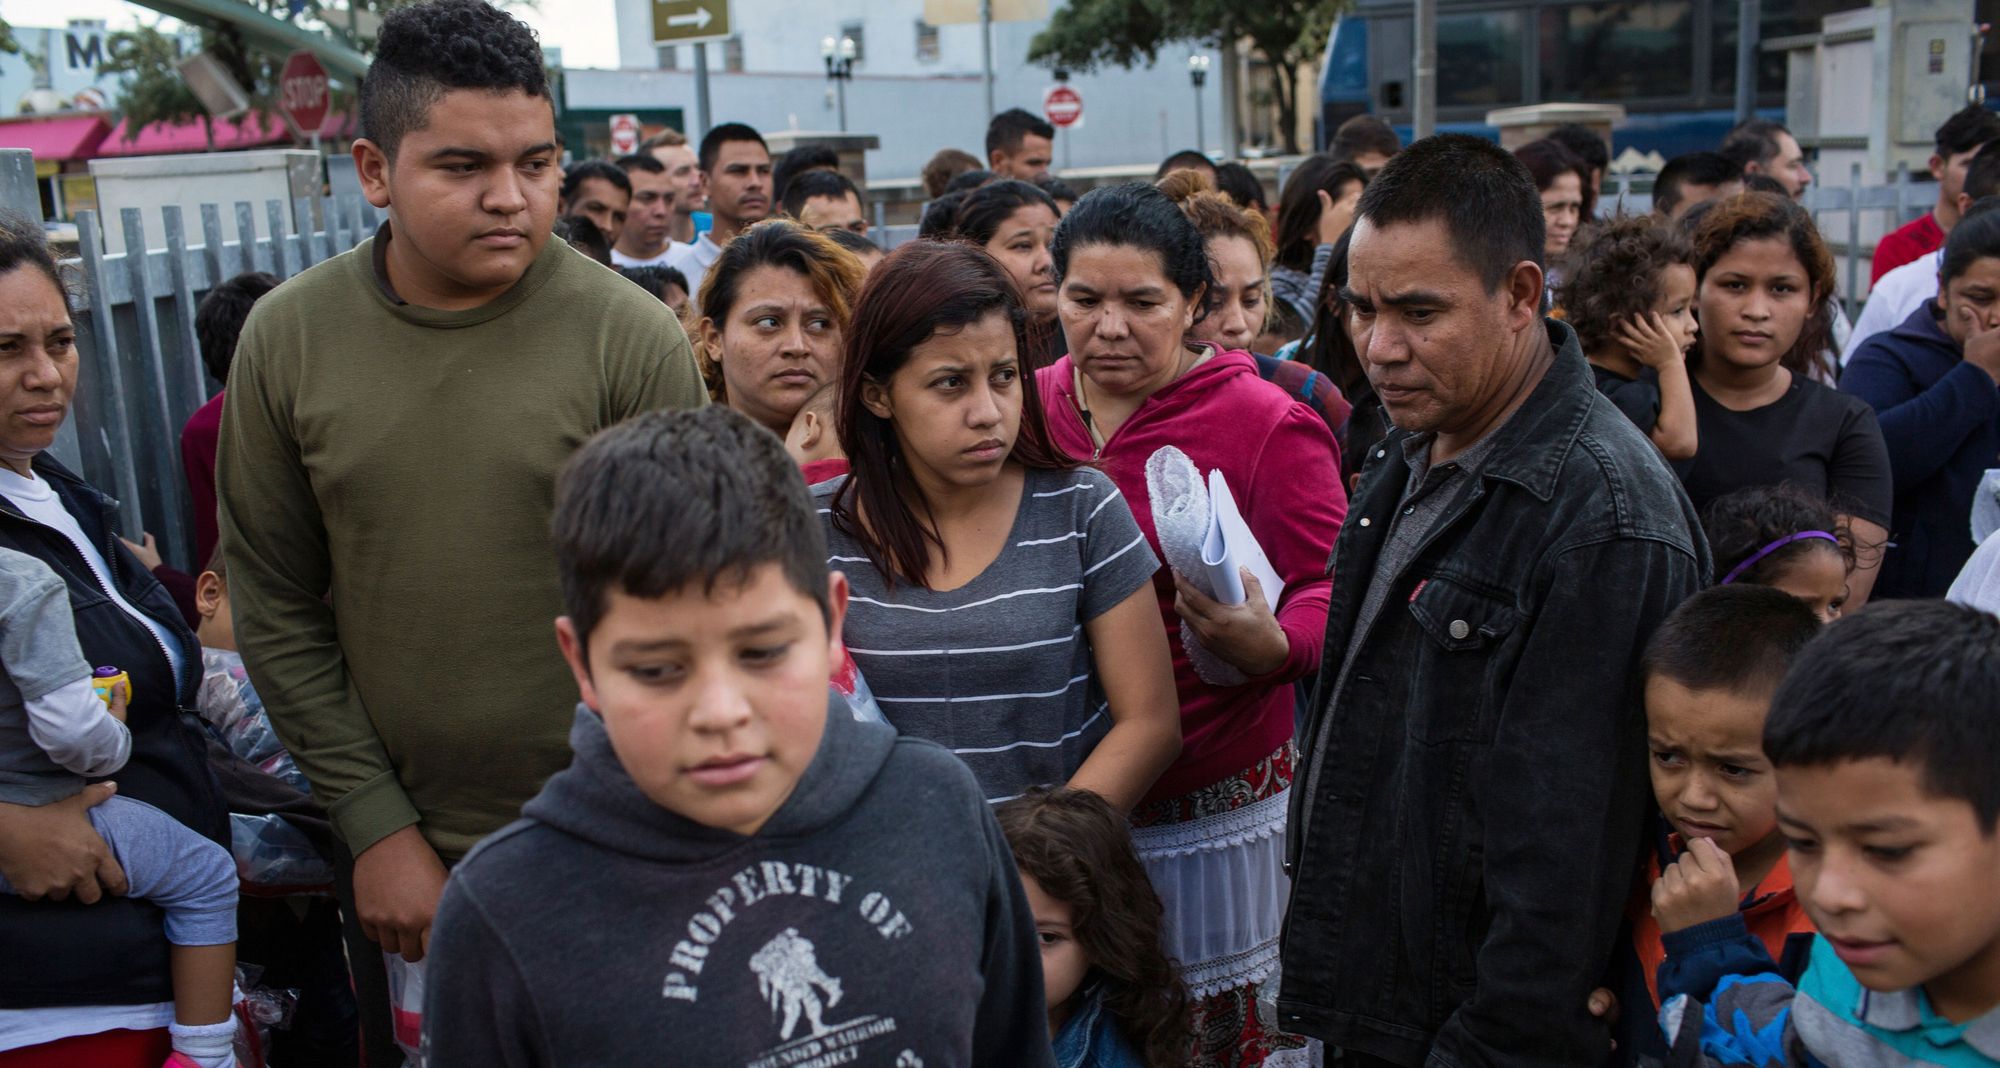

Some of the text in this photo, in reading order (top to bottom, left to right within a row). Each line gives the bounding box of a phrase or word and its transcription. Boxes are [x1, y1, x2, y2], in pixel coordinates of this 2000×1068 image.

[285, 75, 325, 111] STOP
[661, 860, 914, 1002] PROPERTY OF
[824, 1017, 897, 1049] WARRIOR
